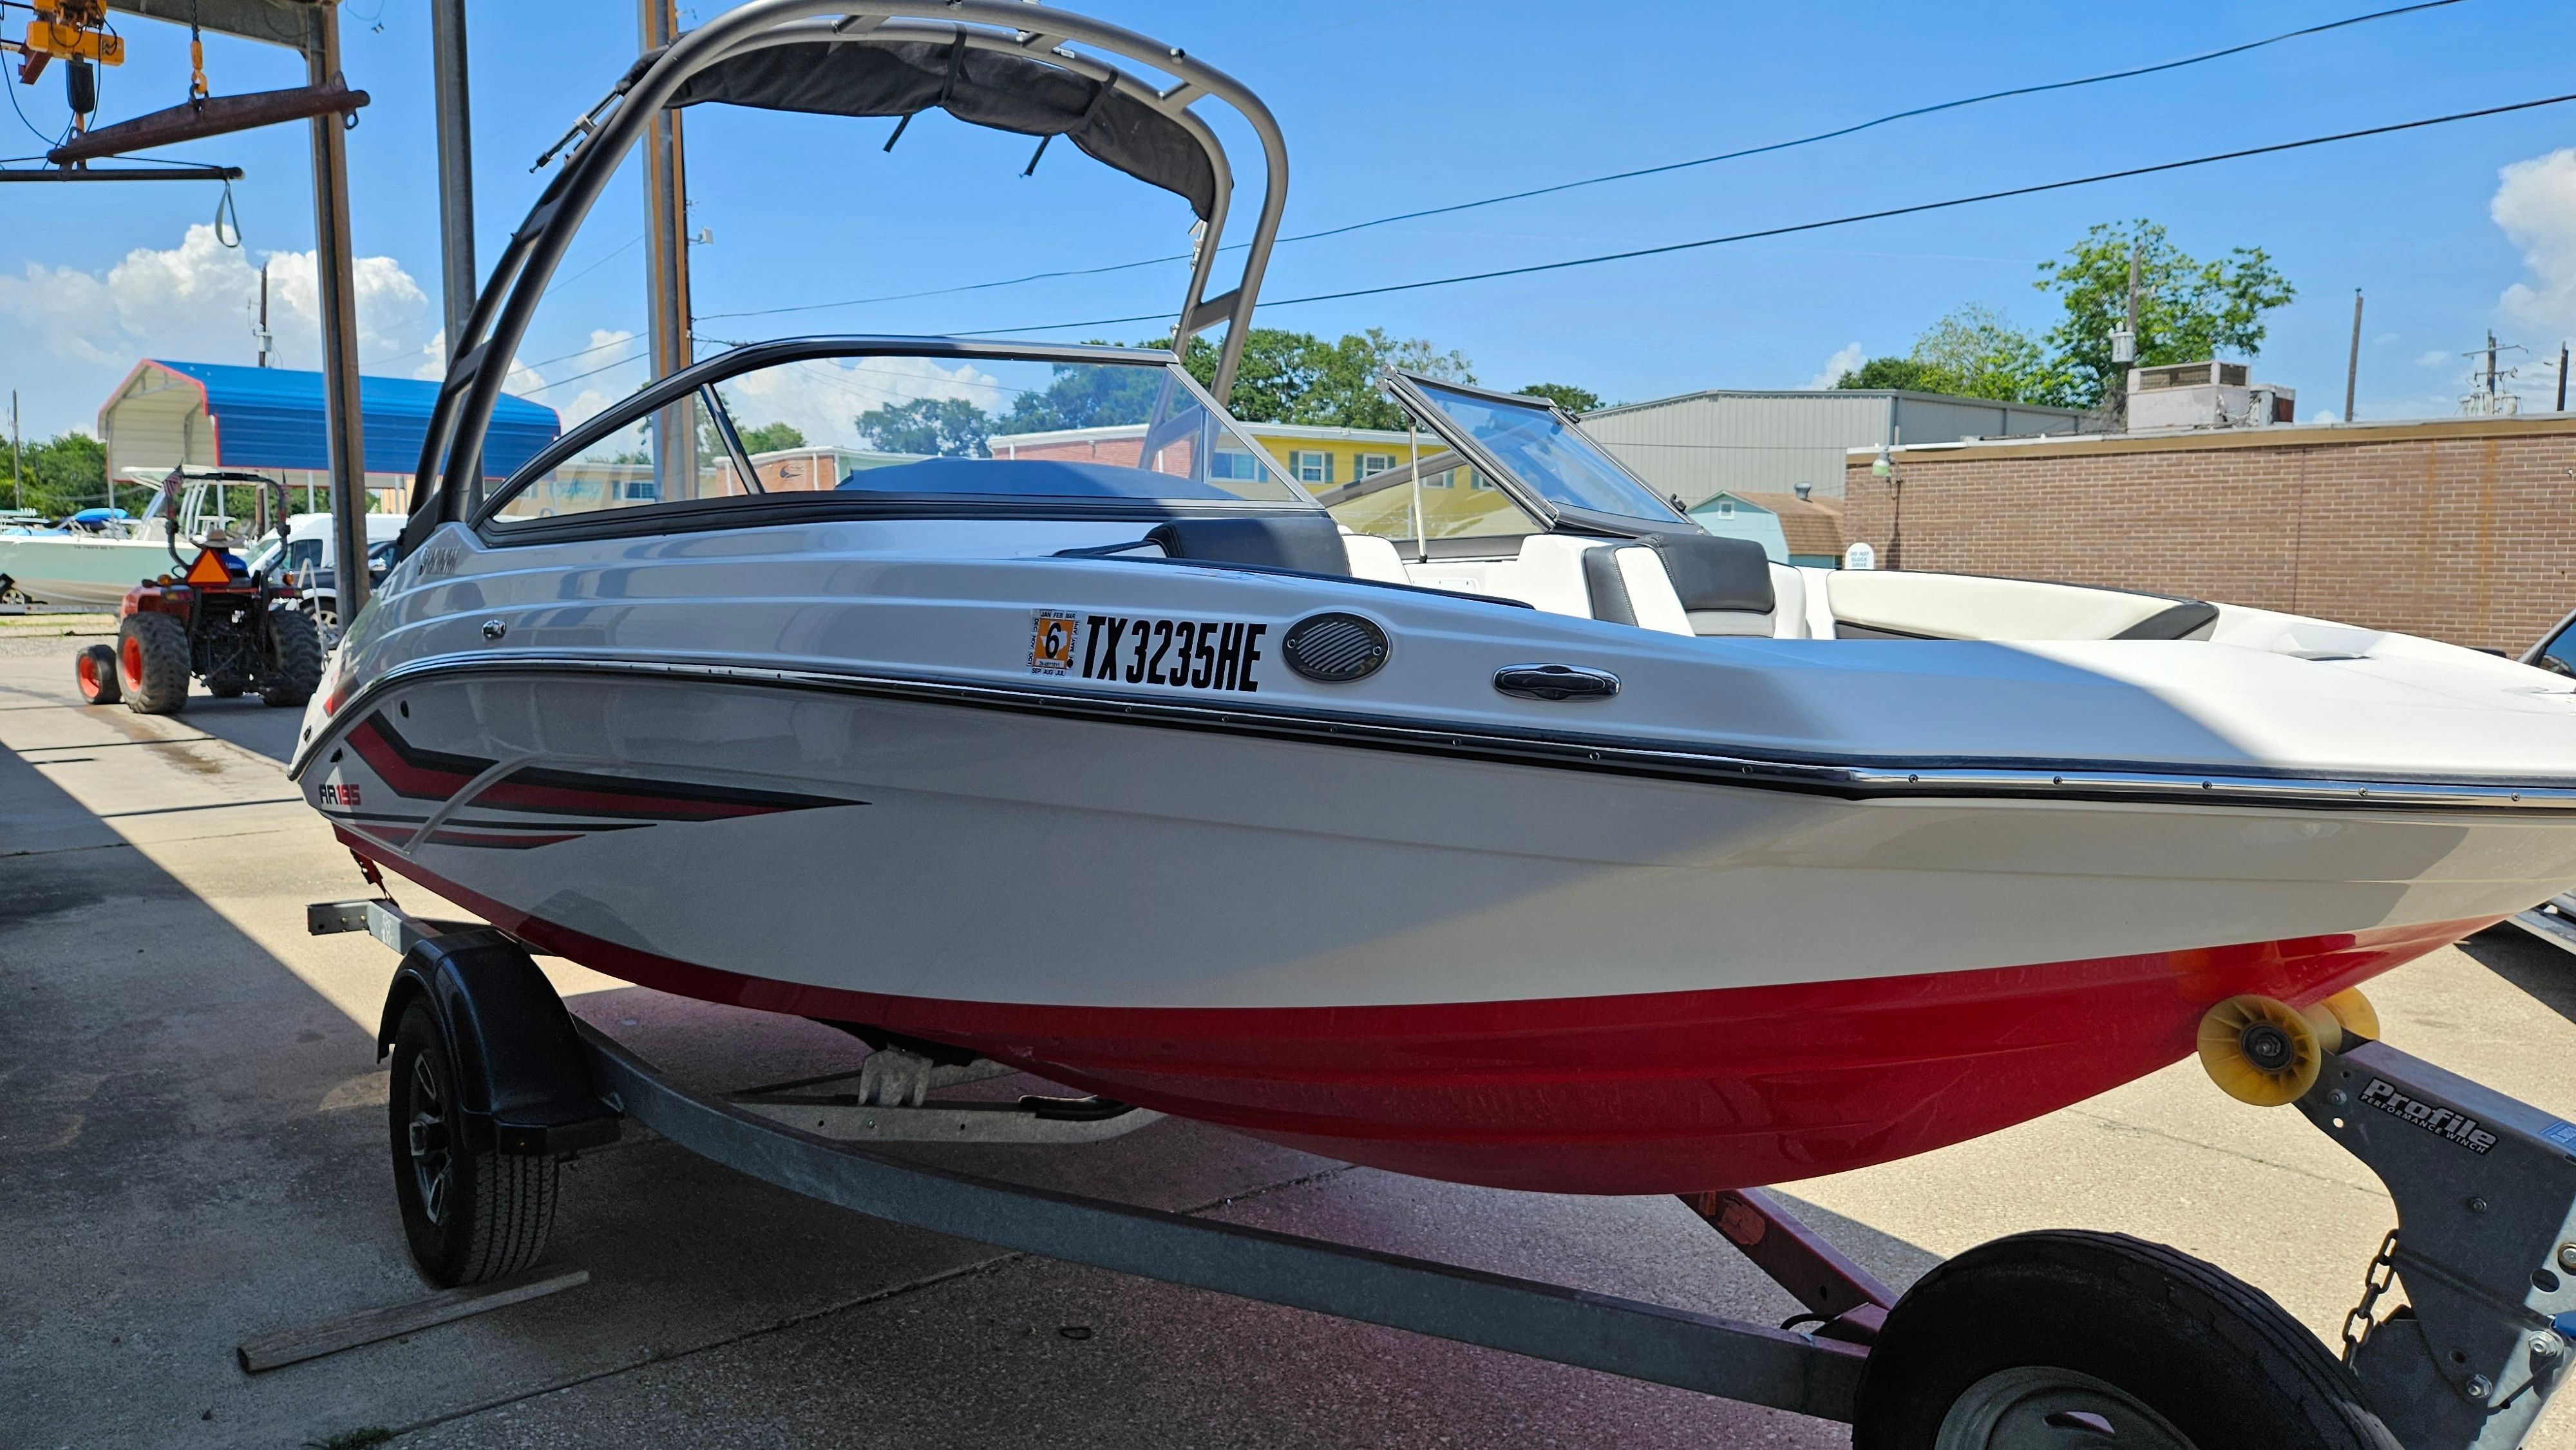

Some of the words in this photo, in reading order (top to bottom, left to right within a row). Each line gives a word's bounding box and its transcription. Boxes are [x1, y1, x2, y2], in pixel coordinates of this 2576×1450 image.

[1045, 622, 1061, 659] 6
[1083, 616, 1128, 681] TX
[319, 784, 361, 805] AR195
[2361, 1095, 2442, 1133] PERFORMANCE
[2447, 1132, 2486, 1153] WINCH
[2363, 1078, 2497, 1149] Profile
